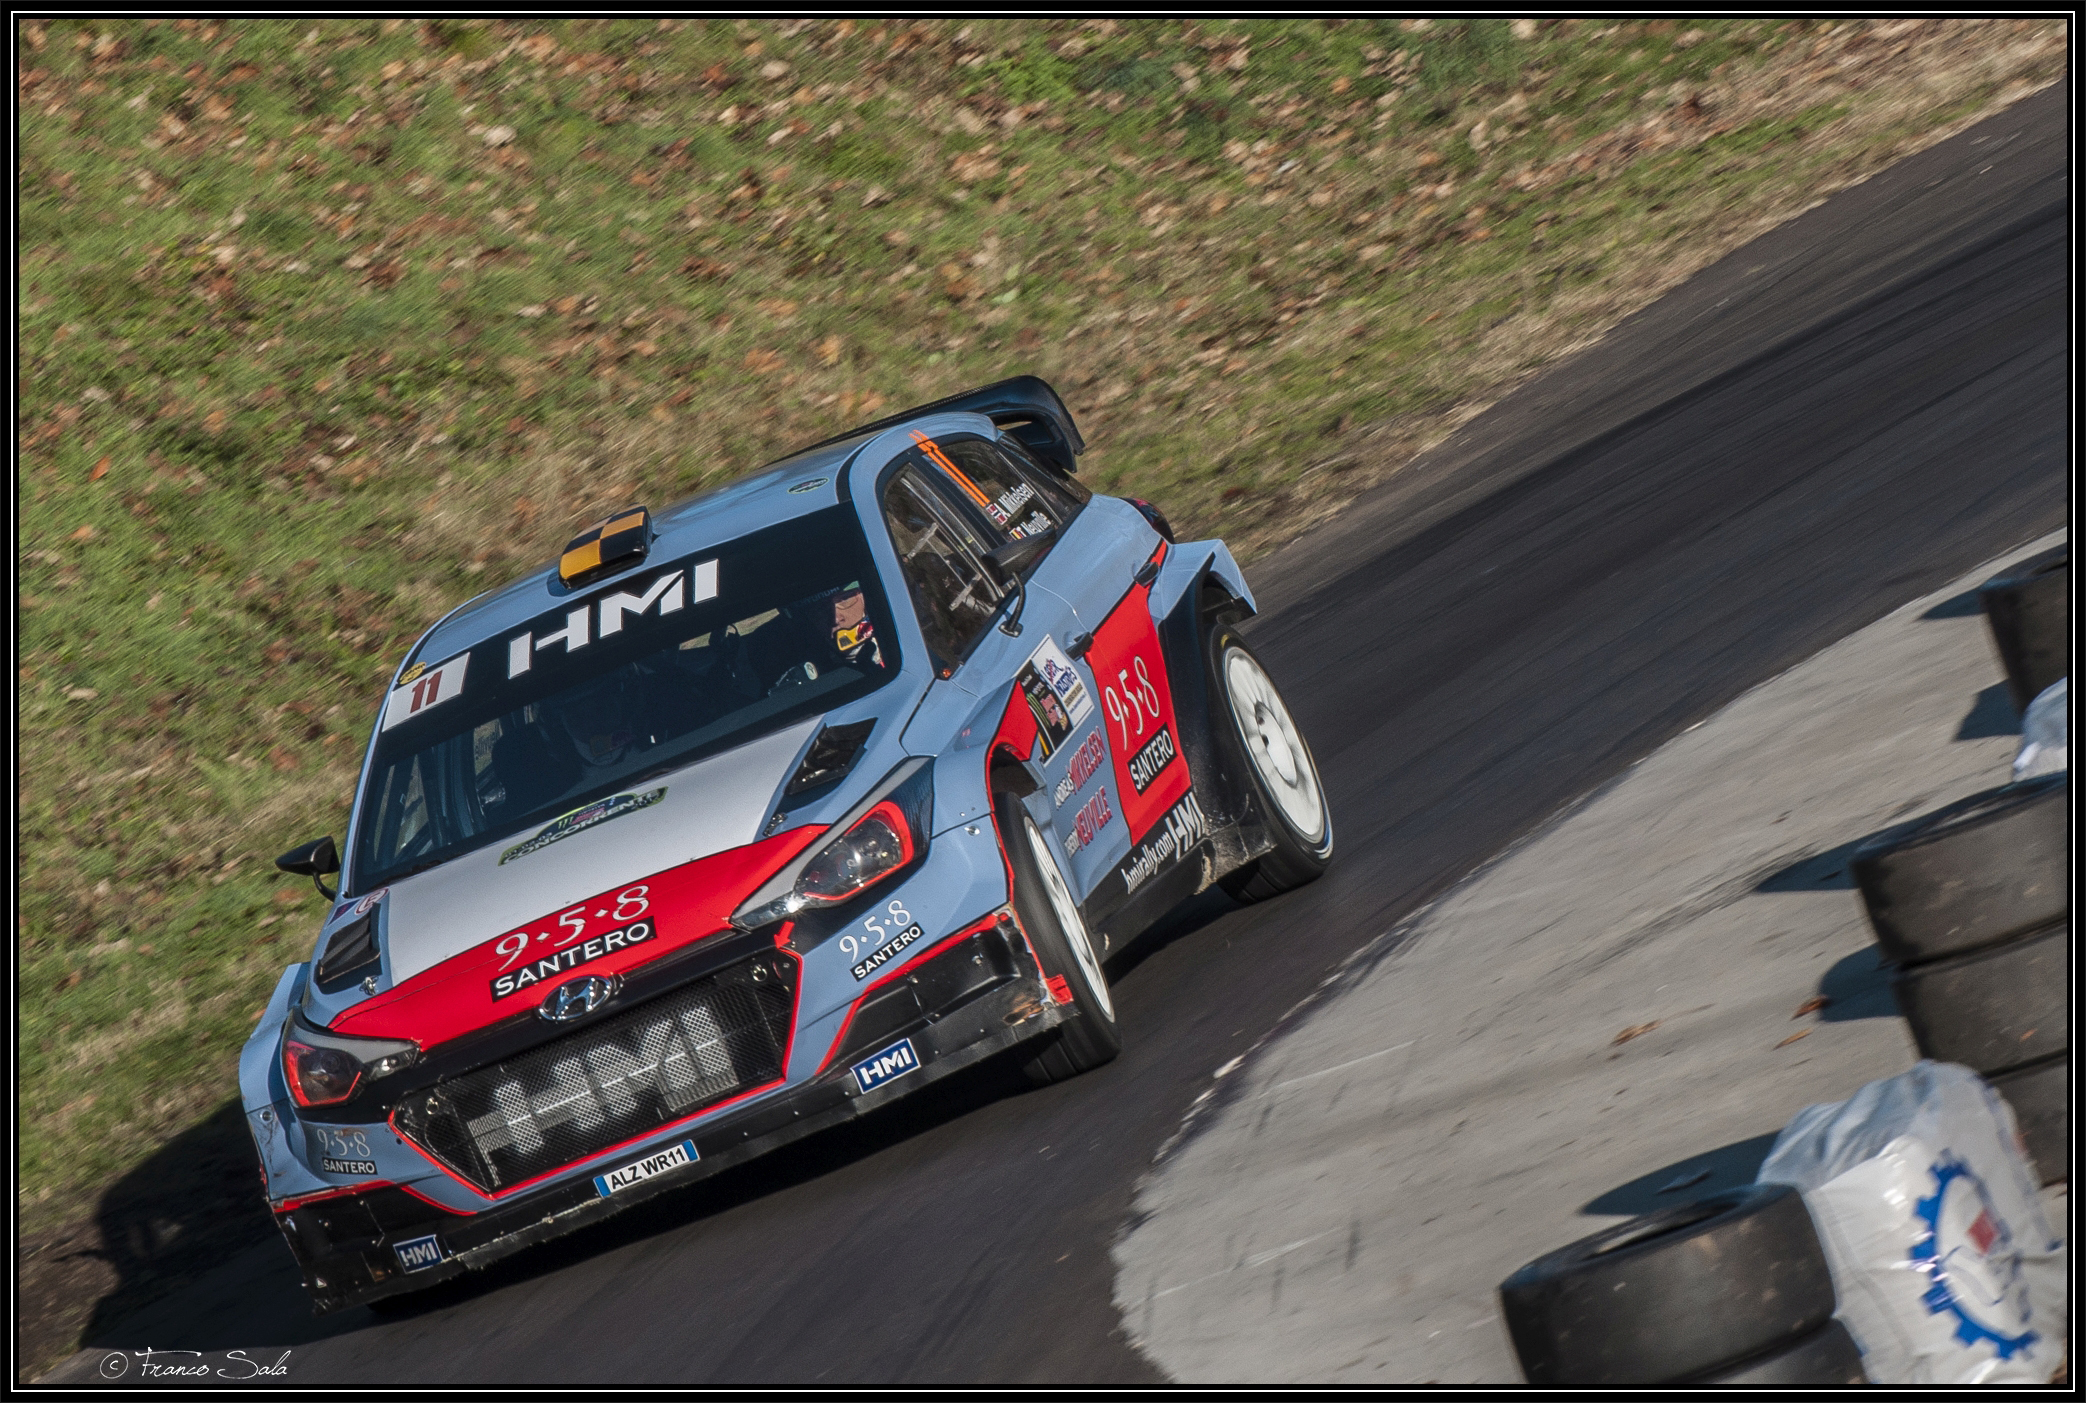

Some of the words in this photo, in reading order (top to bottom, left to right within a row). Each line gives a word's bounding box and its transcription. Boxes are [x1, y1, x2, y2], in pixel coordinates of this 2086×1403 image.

[998, 483, 1035, 515] Mikkelsen
[1020, 510, 1052, 536] Neuville
[509, 558, 719, 679] HMI
[410, 669, 443, 714] 11
[1066, 725, 1106, 795] MIKKELSEN
[1129, 730, 1175, 791] SANTERO
[502, 791, 661, 866] CONCORRENTE
[1072, 785, 1112, 851] NEUVILLE
[1121, 832, 1175, 895] hmirally.com
[1165, 791, 1205, 862] HMI
[495, 922, 650, 996] SANTERO
[854, 926, 921, 979] SANTERO
[494, 1005, 734, 1155] HMI
[860, 1047, 912, 1085] HMI
[323, 1159, 375, 1174] SANTERO
[611, 1165, 642, 1190] ALZ
[640, 1147, 686, 1176] WR11
[400, 1242, 438, 1267] HMI
